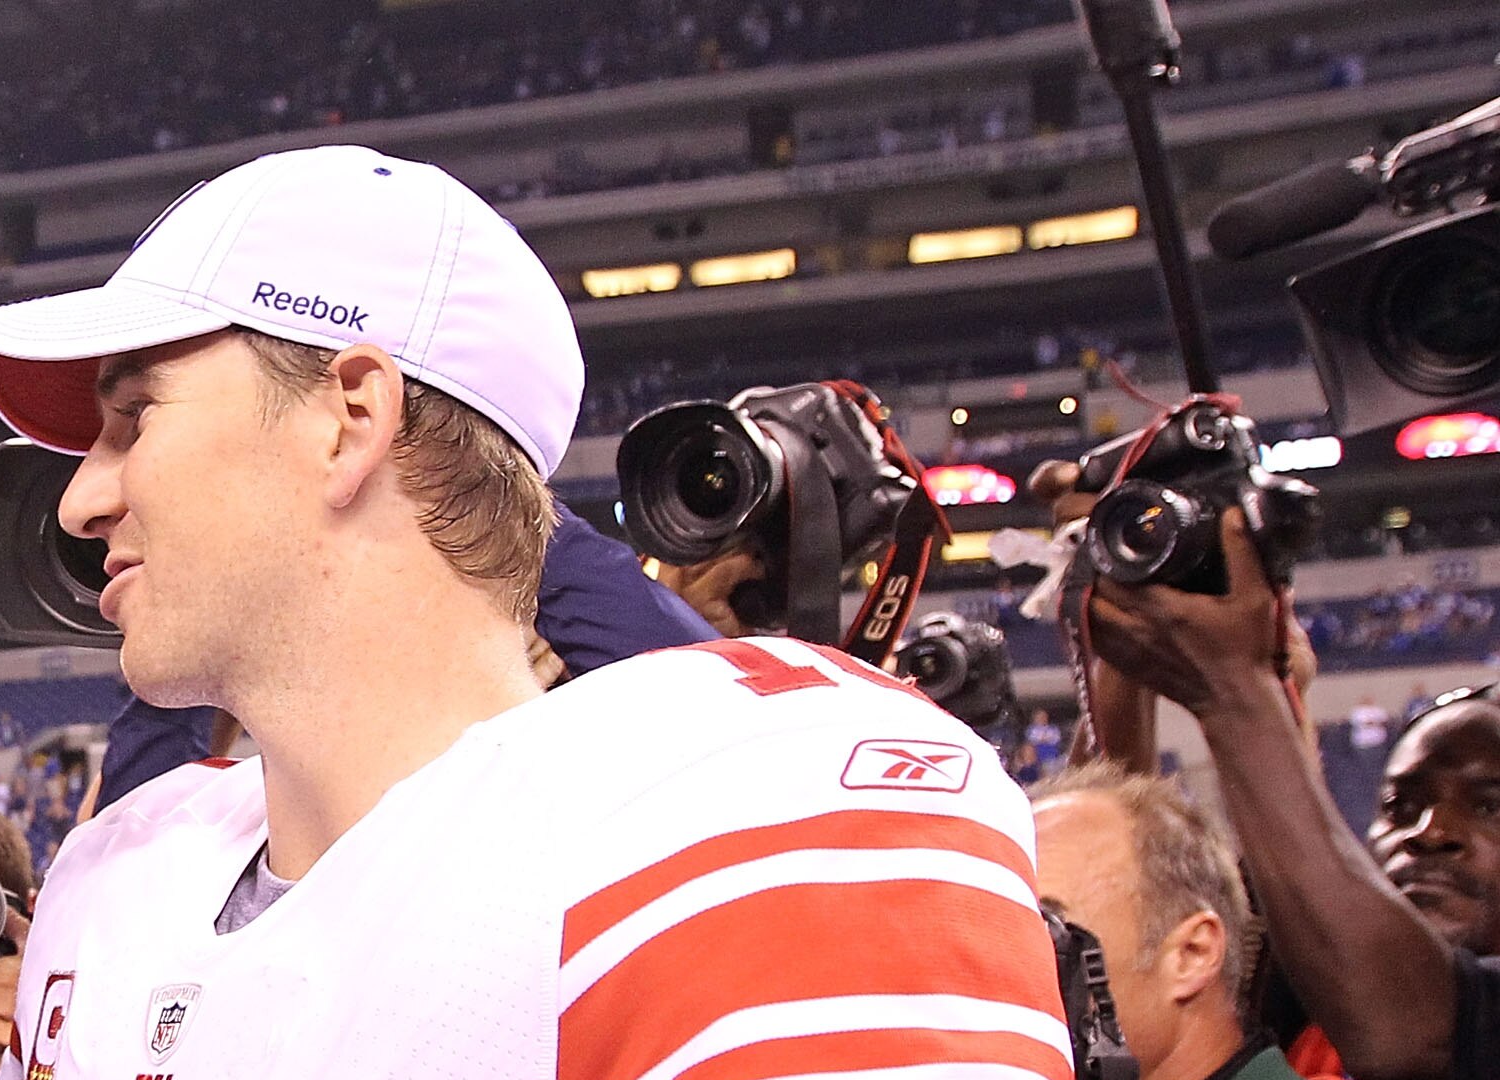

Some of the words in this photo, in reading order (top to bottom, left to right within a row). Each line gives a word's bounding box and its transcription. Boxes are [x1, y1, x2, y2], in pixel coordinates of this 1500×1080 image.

[252, 281, 370, 332] Reebok
[864, 574, 910, 641] EOS
[153, 1024, 176, 1047] NFL
